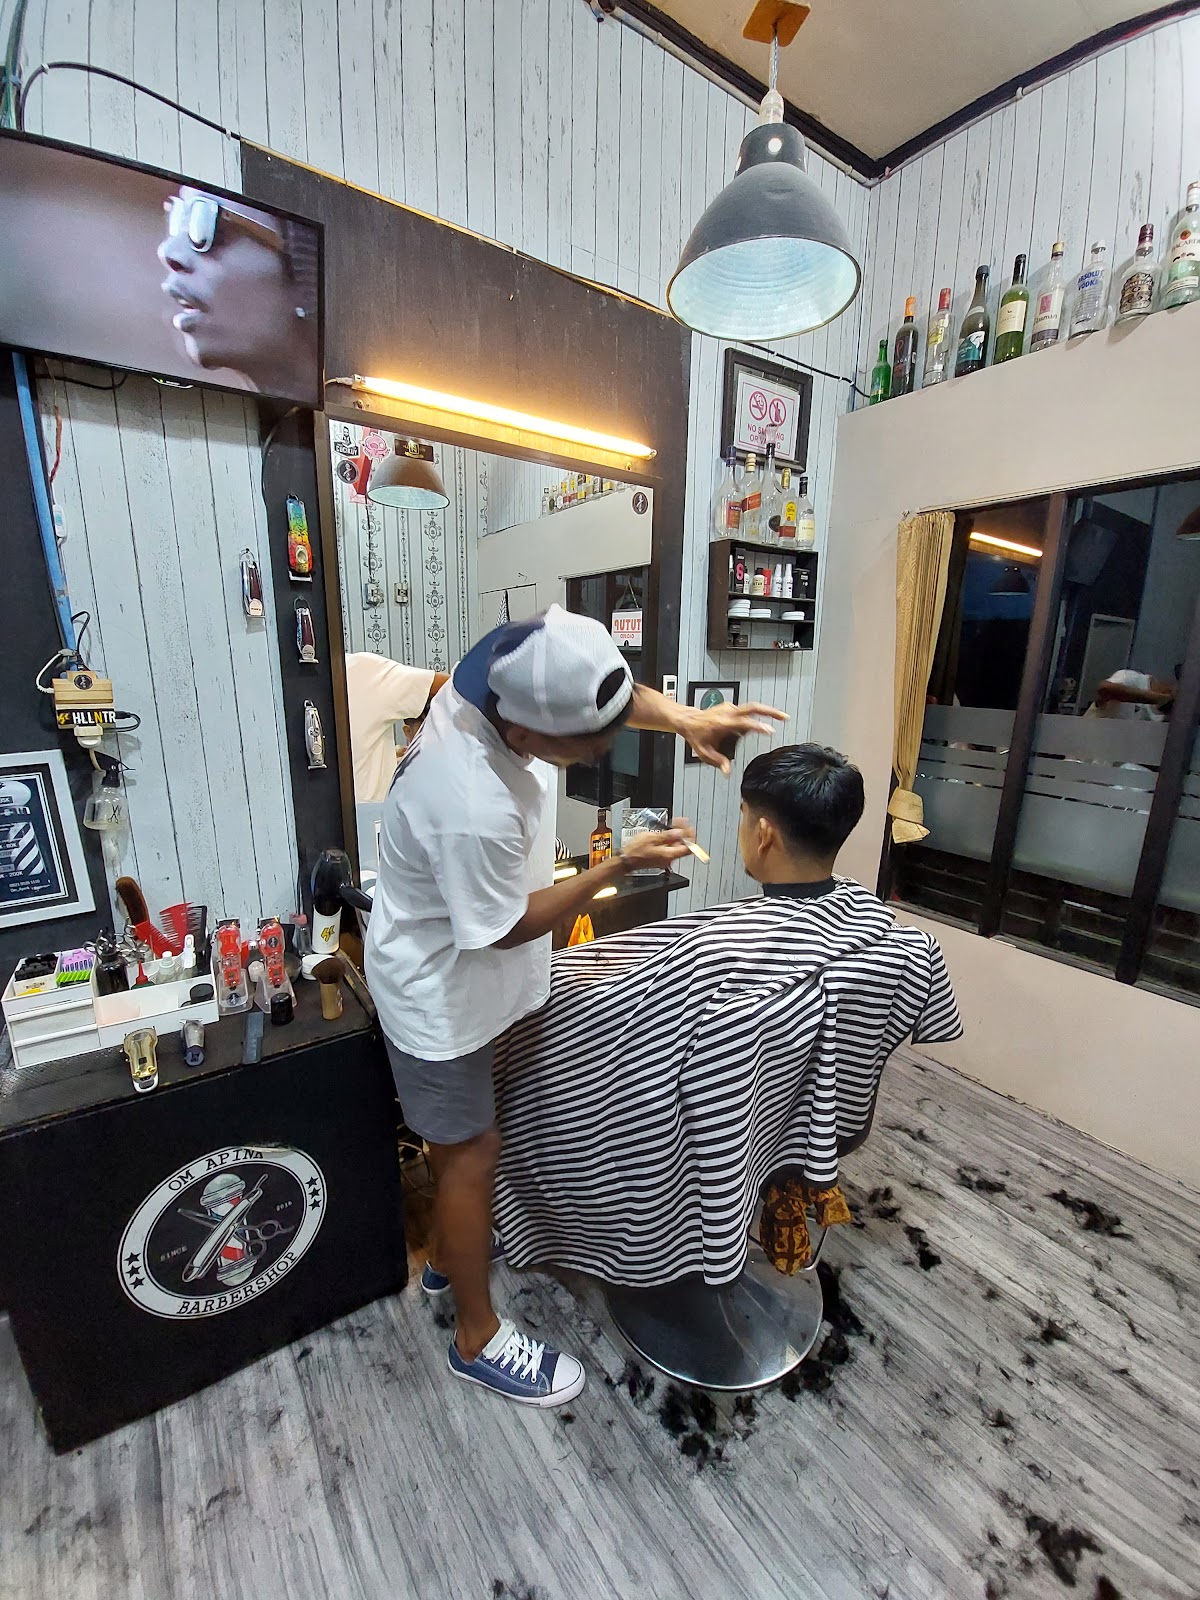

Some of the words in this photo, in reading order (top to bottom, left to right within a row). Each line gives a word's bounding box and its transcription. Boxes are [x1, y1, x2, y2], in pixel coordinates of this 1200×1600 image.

[747, 423, 757, 432] NO
[758, 427, 785, 441] SMNG
[72, 710, 116, 725] HLLNTR
[168, 1169, 195, 1191] OM
[176, 1251, 297, 1315] BARBERSHOP
